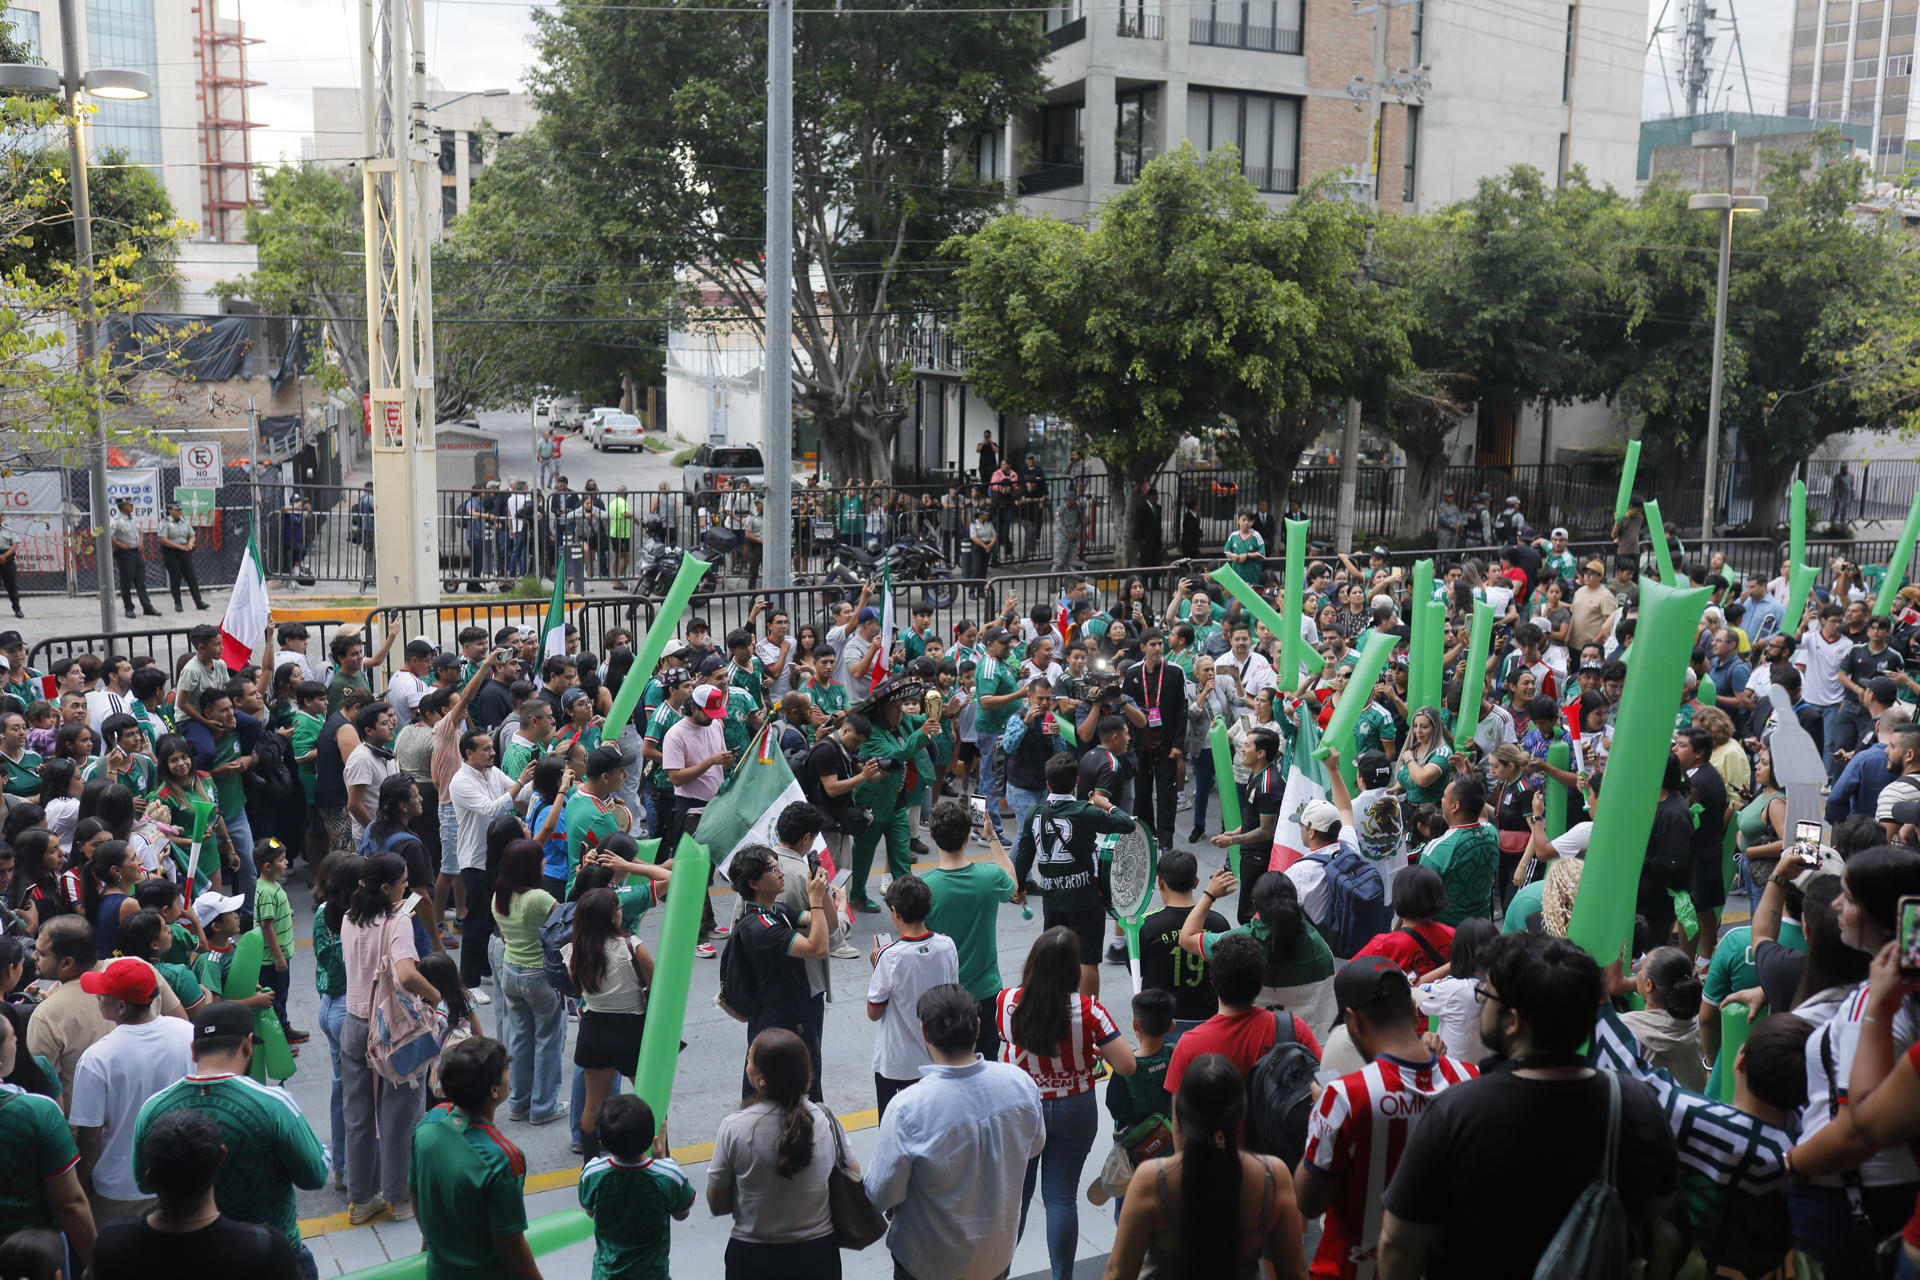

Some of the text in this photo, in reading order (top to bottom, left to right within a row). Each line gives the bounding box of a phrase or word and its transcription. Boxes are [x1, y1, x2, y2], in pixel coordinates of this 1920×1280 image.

[135, 507, 153, 517] EPP
[1032, 814, 1076, 864] 12
[1169, 946, 1204, 987] 19
